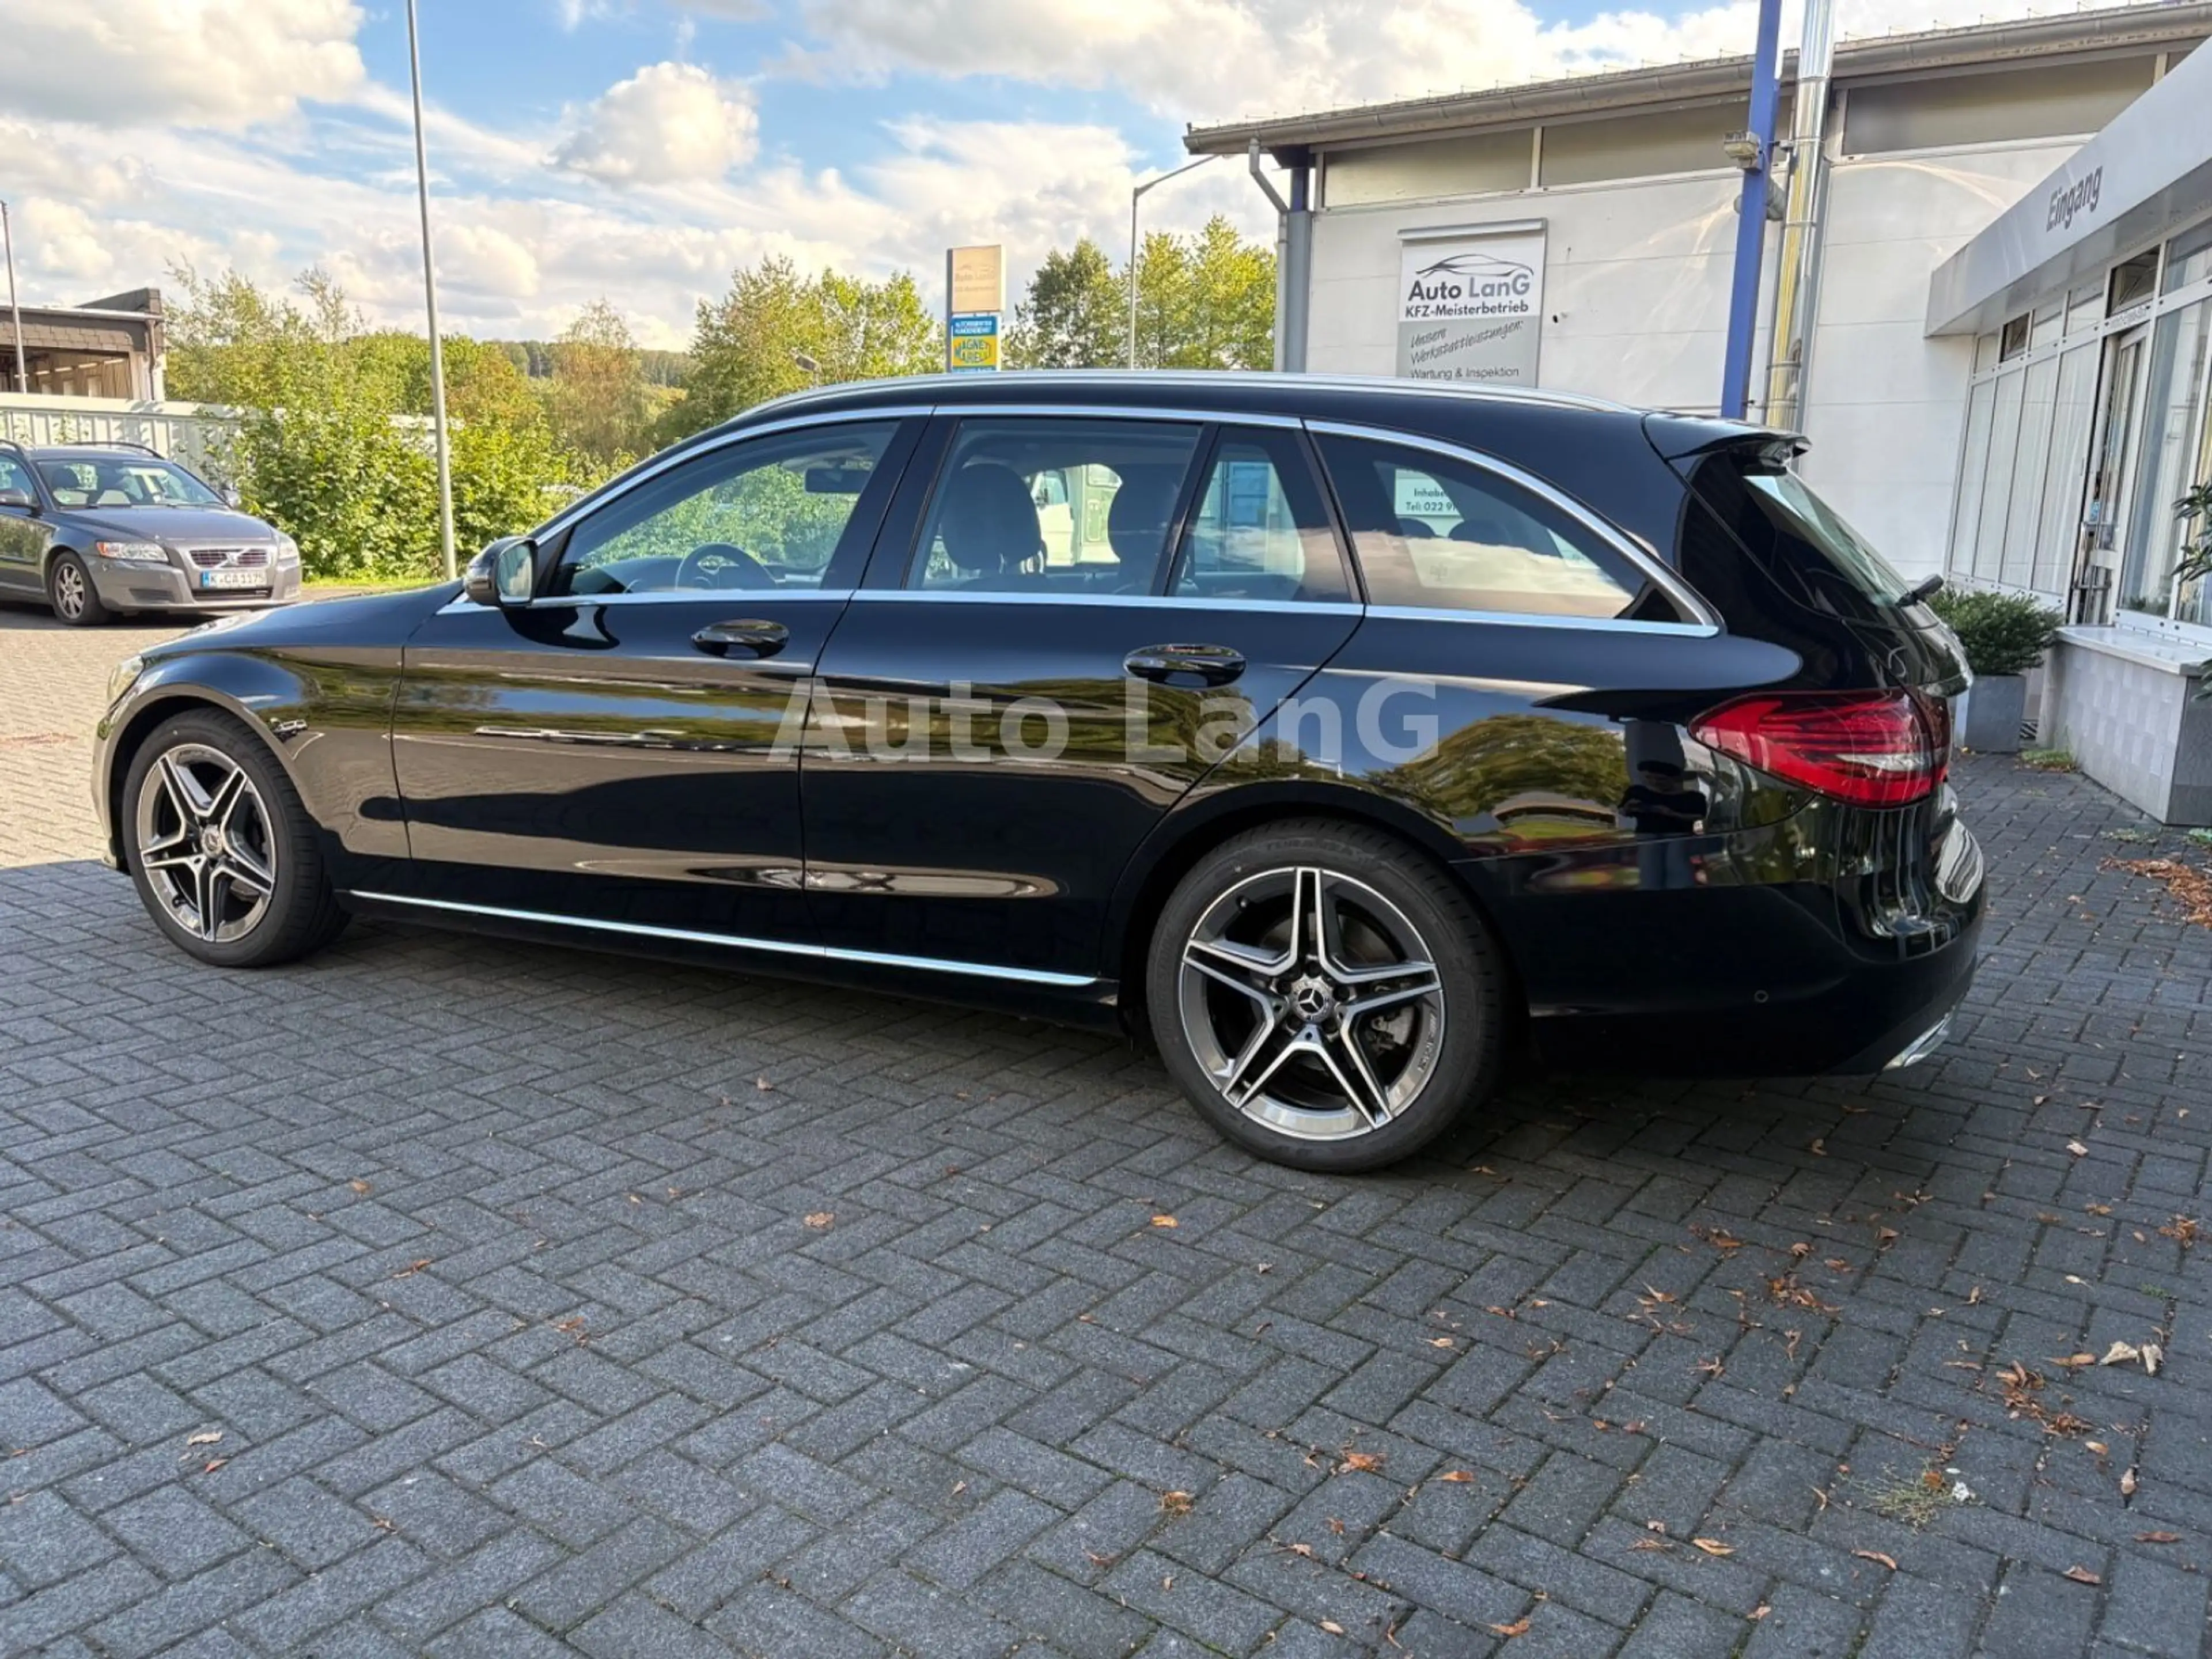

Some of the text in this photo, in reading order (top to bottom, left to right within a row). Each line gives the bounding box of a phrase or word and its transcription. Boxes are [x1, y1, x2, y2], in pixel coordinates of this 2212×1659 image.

[2046, 165, 2103, 233] Eingang
[1408, 273, 1530, 301] Auto LanG
[1405, 300, 1529, 317] KFZ-Meisterbetrieb
[1411, 327, 1447, 348] Unsere
[1411, 321, 1524, 365] Werkstattleistungen:
[1411, 365, 1519, 380] Wartung & Inspektion
[1424, 502, 1443, 512] 022
